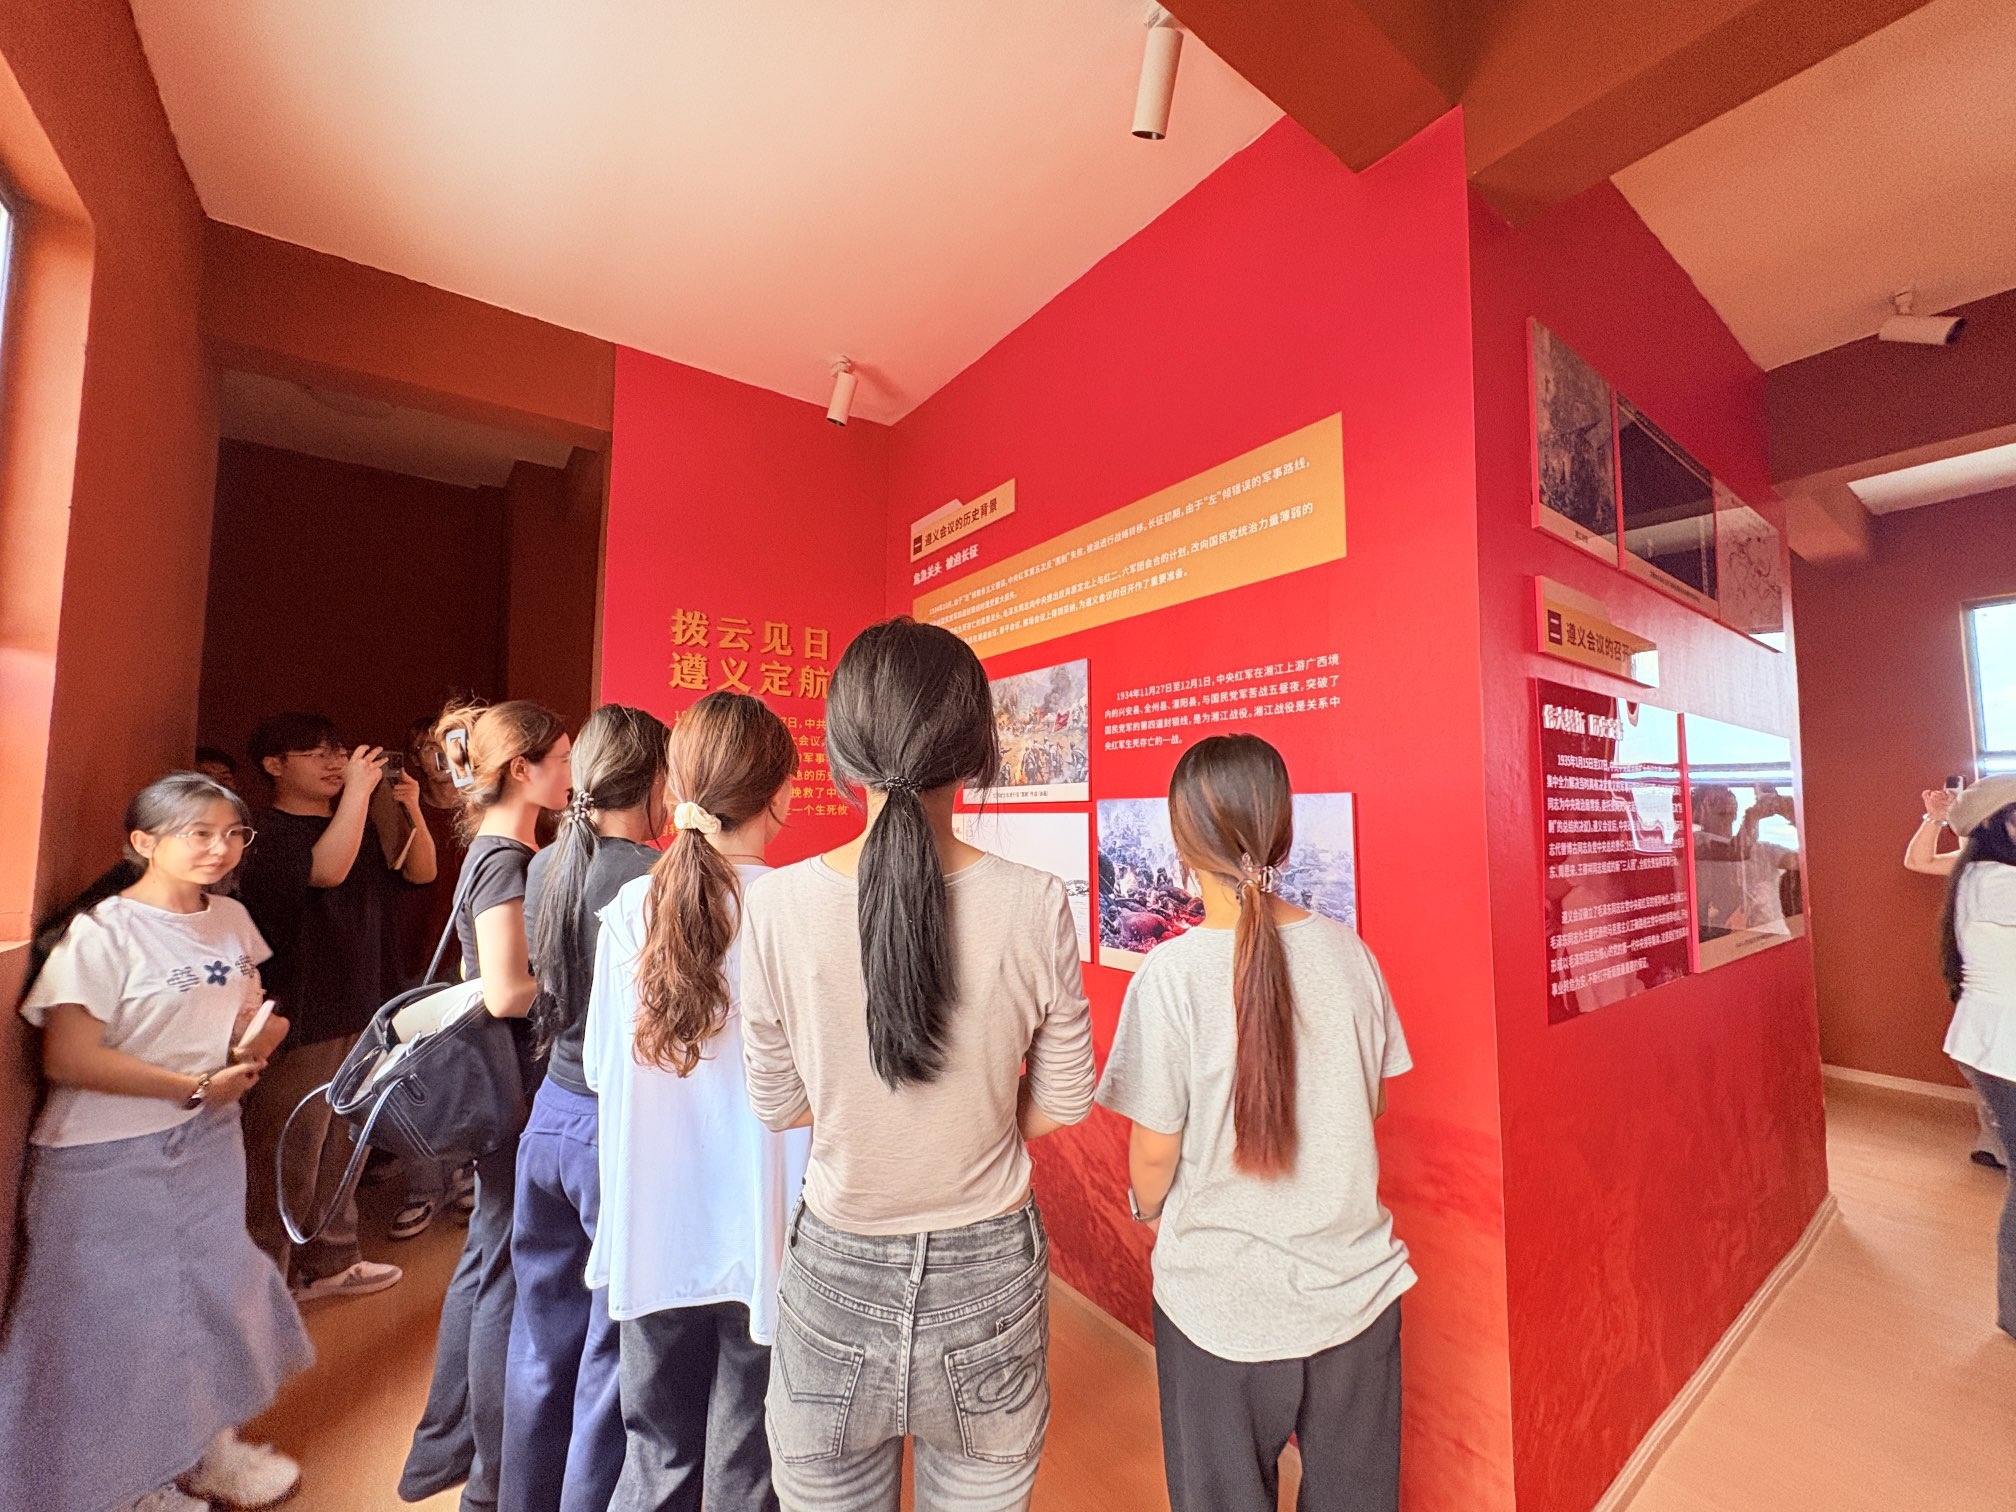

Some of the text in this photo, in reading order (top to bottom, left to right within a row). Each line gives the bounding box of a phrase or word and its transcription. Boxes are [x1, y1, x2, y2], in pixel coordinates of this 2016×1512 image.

[925, 498, 997, 546] 遵义会议的历史背景
[945, 543, 979, 571] 被迫长征
[671, 608, 828, 660] 拨云见日
[669, 652, 831, 699] 遵义定航
[786, 804, 848, 816] 一个生死攸
